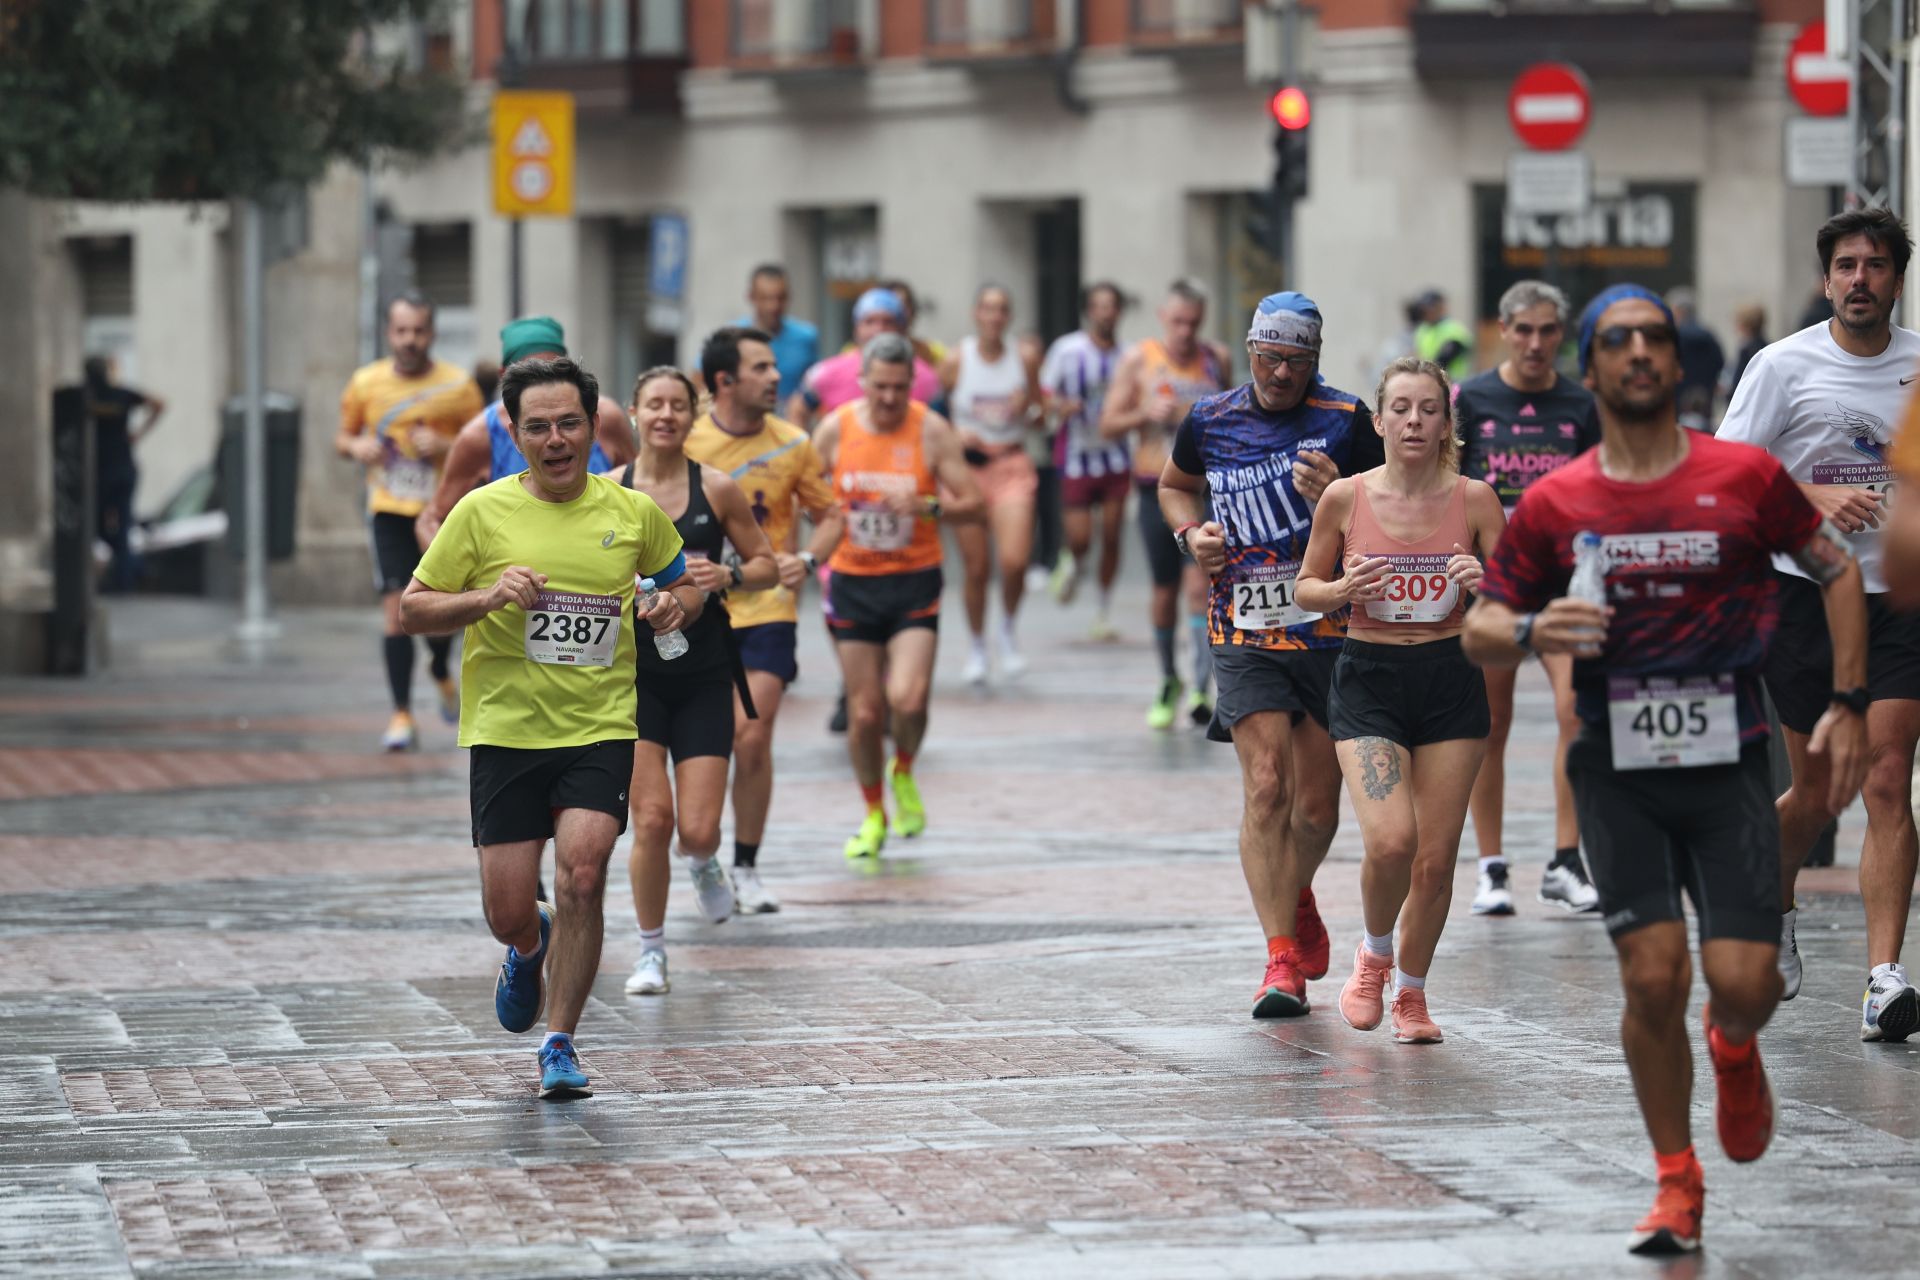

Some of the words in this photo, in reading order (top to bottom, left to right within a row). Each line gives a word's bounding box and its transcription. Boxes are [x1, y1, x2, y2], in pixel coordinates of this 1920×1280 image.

[1297, 438, 1327, 449] HOKA
[1227, 452, 1292, 492] MARATÓN
[1814, 467, 1837, 475] XXXVI
[1839, 467, 1867, 475] MEDIA
[1846, 473, 1898, 483] VALLADOLID
[1211, 478, 1315, 547] EVILL
[1388, 556, 1416, 564] MEDIA
[1252, 566, 1277, 575] MEDIA
[1395, 565, 1446, 573] VALLADOLID
[1376, 574, 1447, 602] 309
[554, 595, 583, 605] MEDIA
[584, 596, 621, 607] MARATÓN
[1238, 583, 1295, 610] 211
[547, 603, 559, 611] DE
[561, 604, 611, 615] VALLADOLID
[530, 612, 611, 646] 2387
[555, 646, 585, 654] NAVARRO
[1631, 701, 1708, 739] 405
